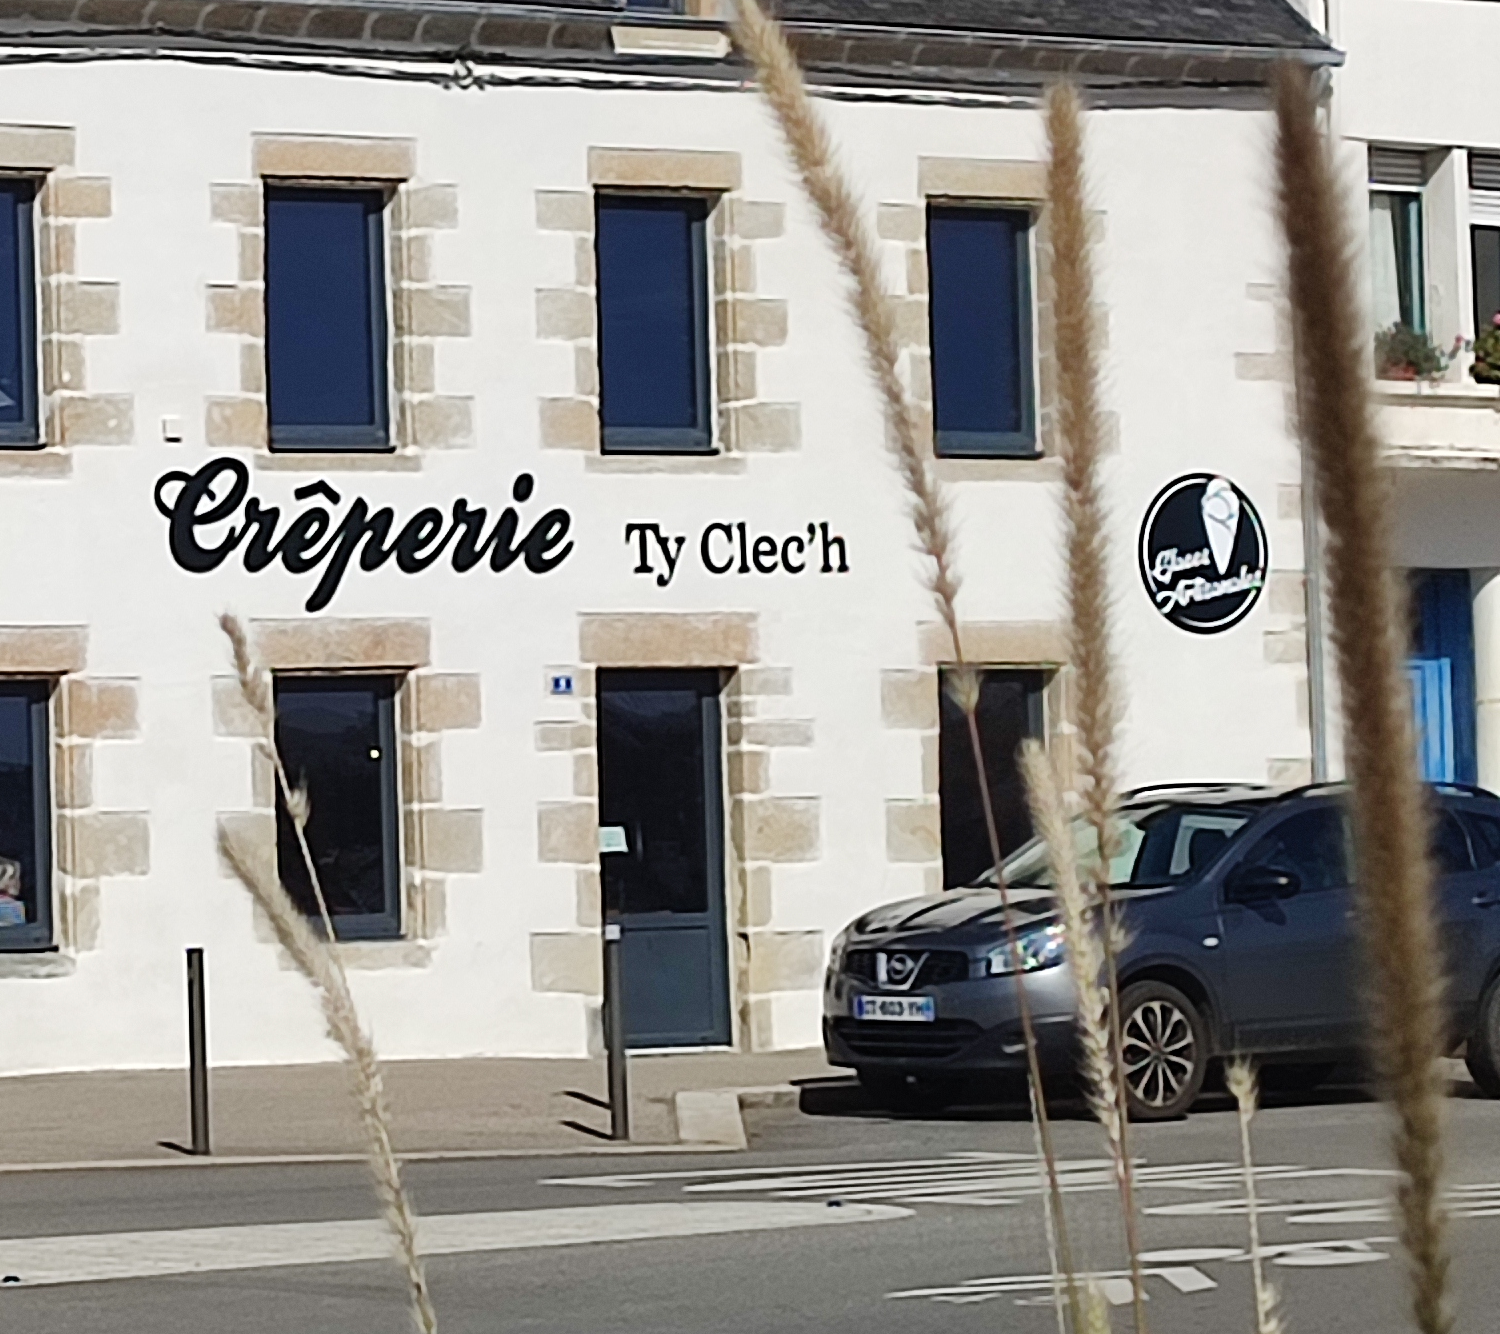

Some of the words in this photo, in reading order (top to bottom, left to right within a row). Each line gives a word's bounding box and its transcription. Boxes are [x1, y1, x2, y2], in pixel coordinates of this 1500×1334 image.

[153, 456, 574, 613] Crêperie
[625, 523, 686, 587] Ty
[700, 521, 850, 575] Clec'h
